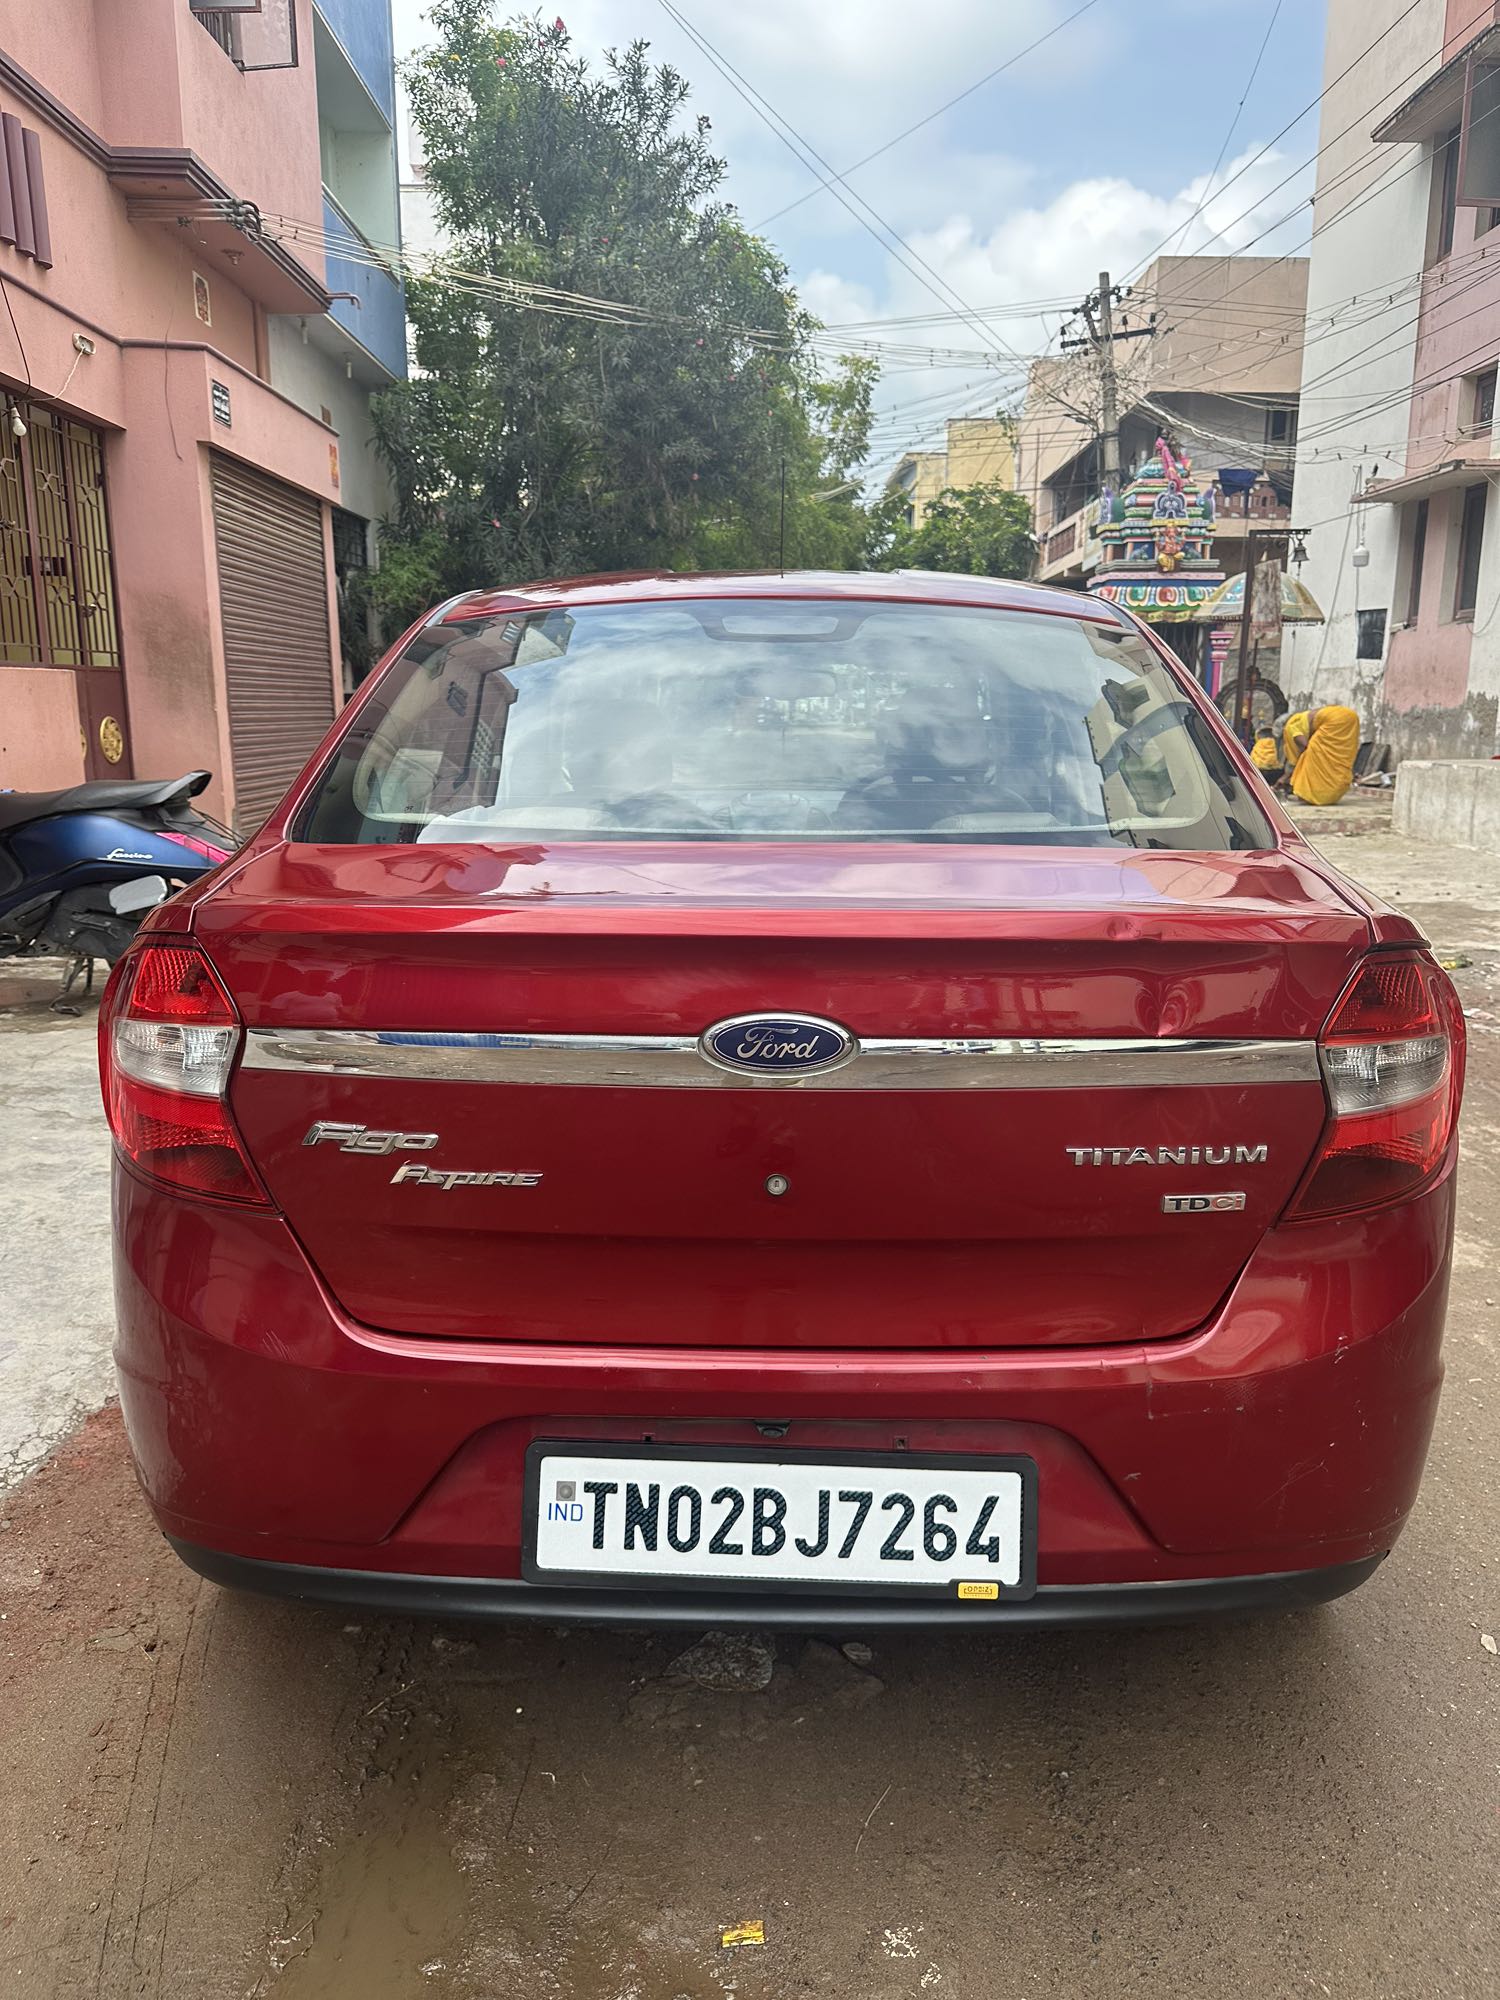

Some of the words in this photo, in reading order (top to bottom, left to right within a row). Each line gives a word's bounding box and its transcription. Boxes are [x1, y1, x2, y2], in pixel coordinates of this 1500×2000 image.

[736, 1026, 820, 1059] Ford
[301, 1120, 439, 1155] Figo
[1066, 1145, 1268, 1166] TITANIUM
[1168, 1196, 1244, 1211] TDCi
[548, 1502, 583, 1522] IND
[583, 1481, 1000, 1563] TN02BJ7264
